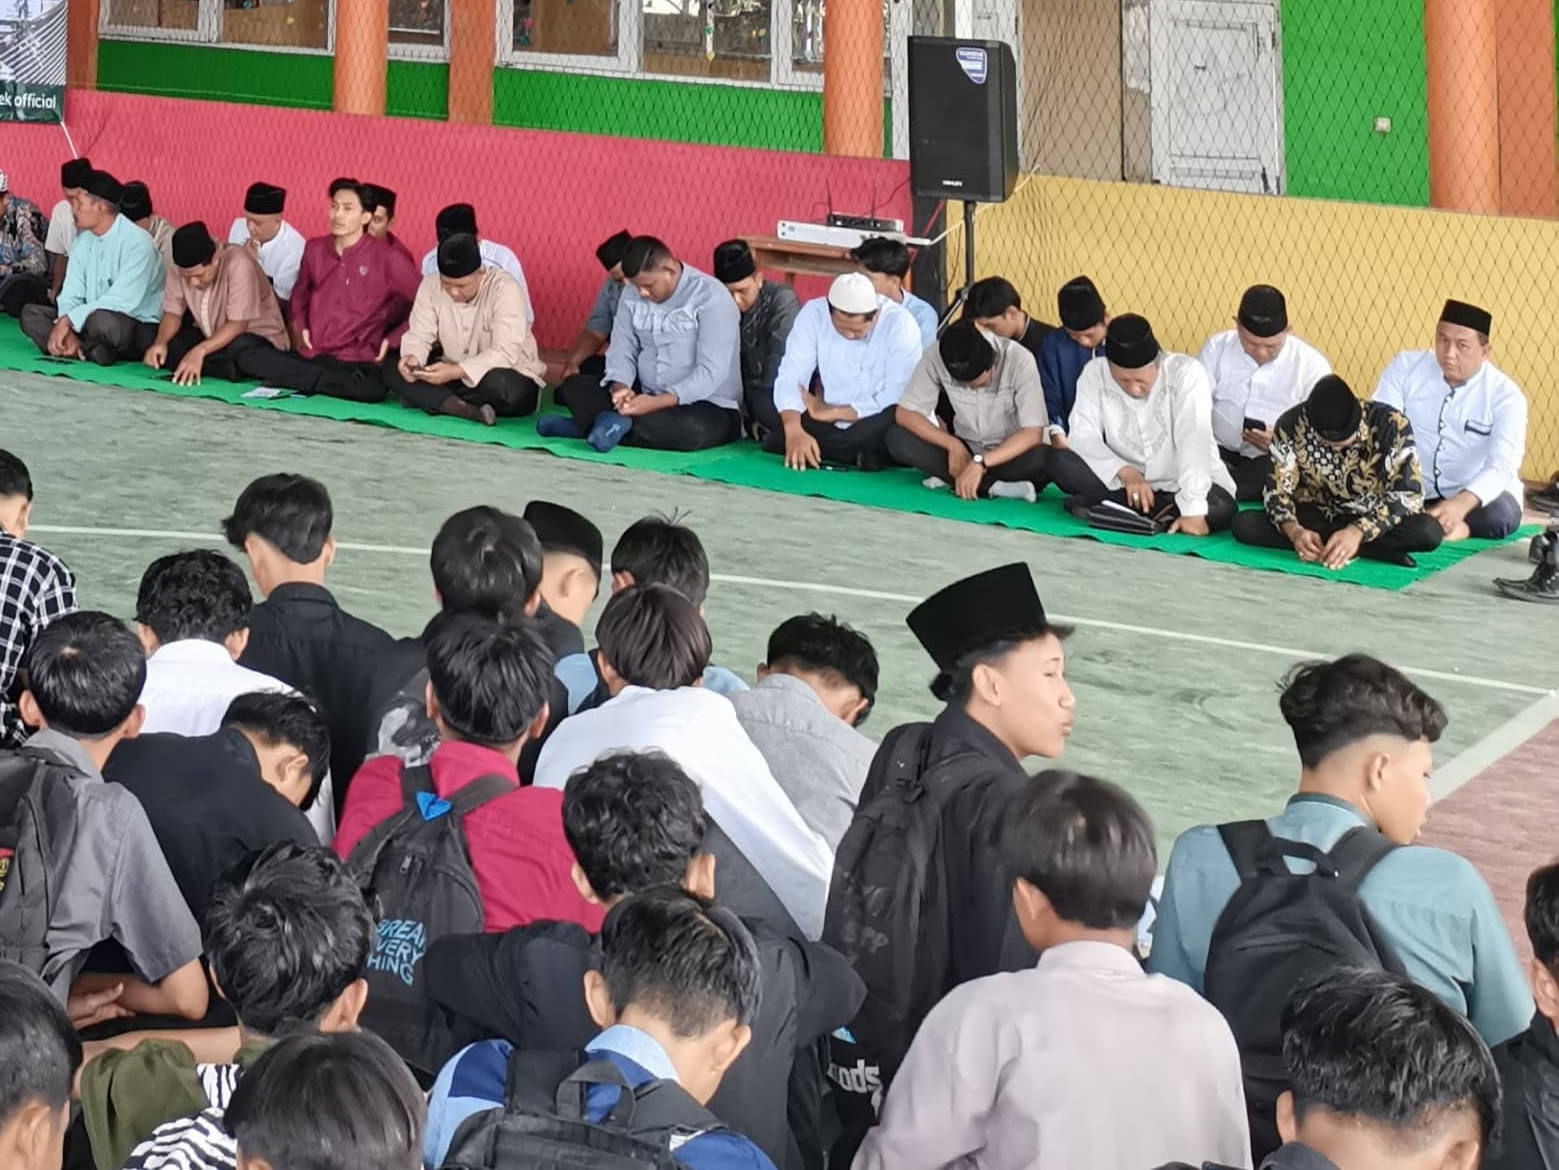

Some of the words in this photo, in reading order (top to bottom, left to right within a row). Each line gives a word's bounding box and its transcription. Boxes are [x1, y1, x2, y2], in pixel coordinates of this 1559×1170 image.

[14, 93, 57, 109] official
[375, 938, 425, 966] VERY
[366, 951, 414, 987] HING
